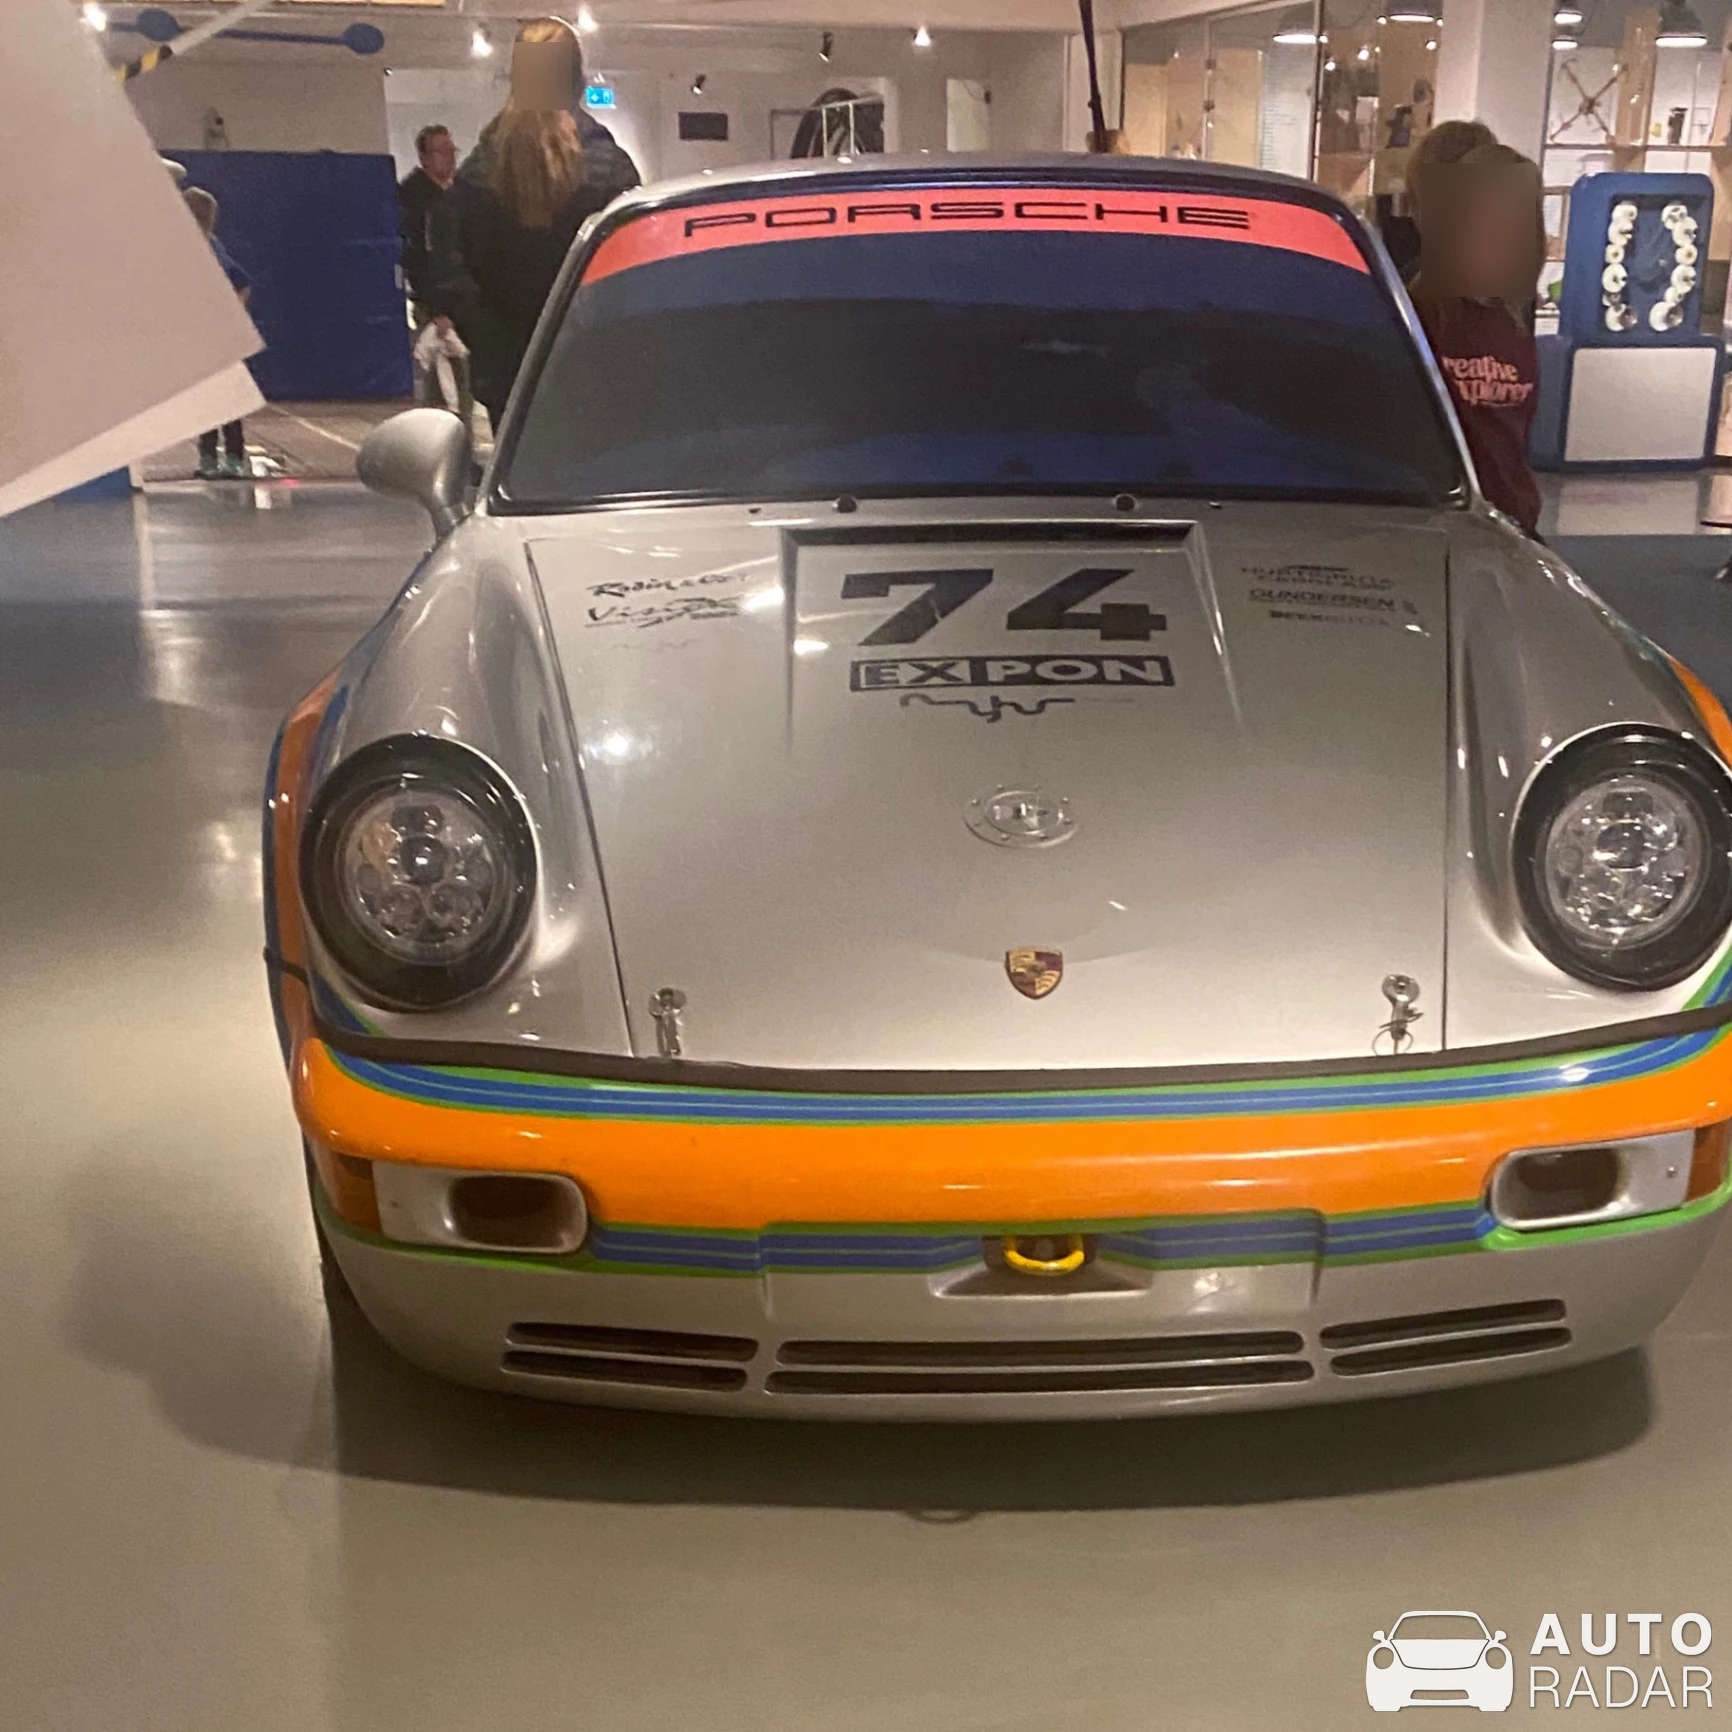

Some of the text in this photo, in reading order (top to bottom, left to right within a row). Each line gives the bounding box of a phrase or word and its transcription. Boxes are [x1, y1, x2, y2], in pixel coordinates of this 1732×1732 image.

[684, 200, 1250, 238] PORSCHE
[1441, 355, 1519, 382] reative
[841, 568, 1167, 647] 74
